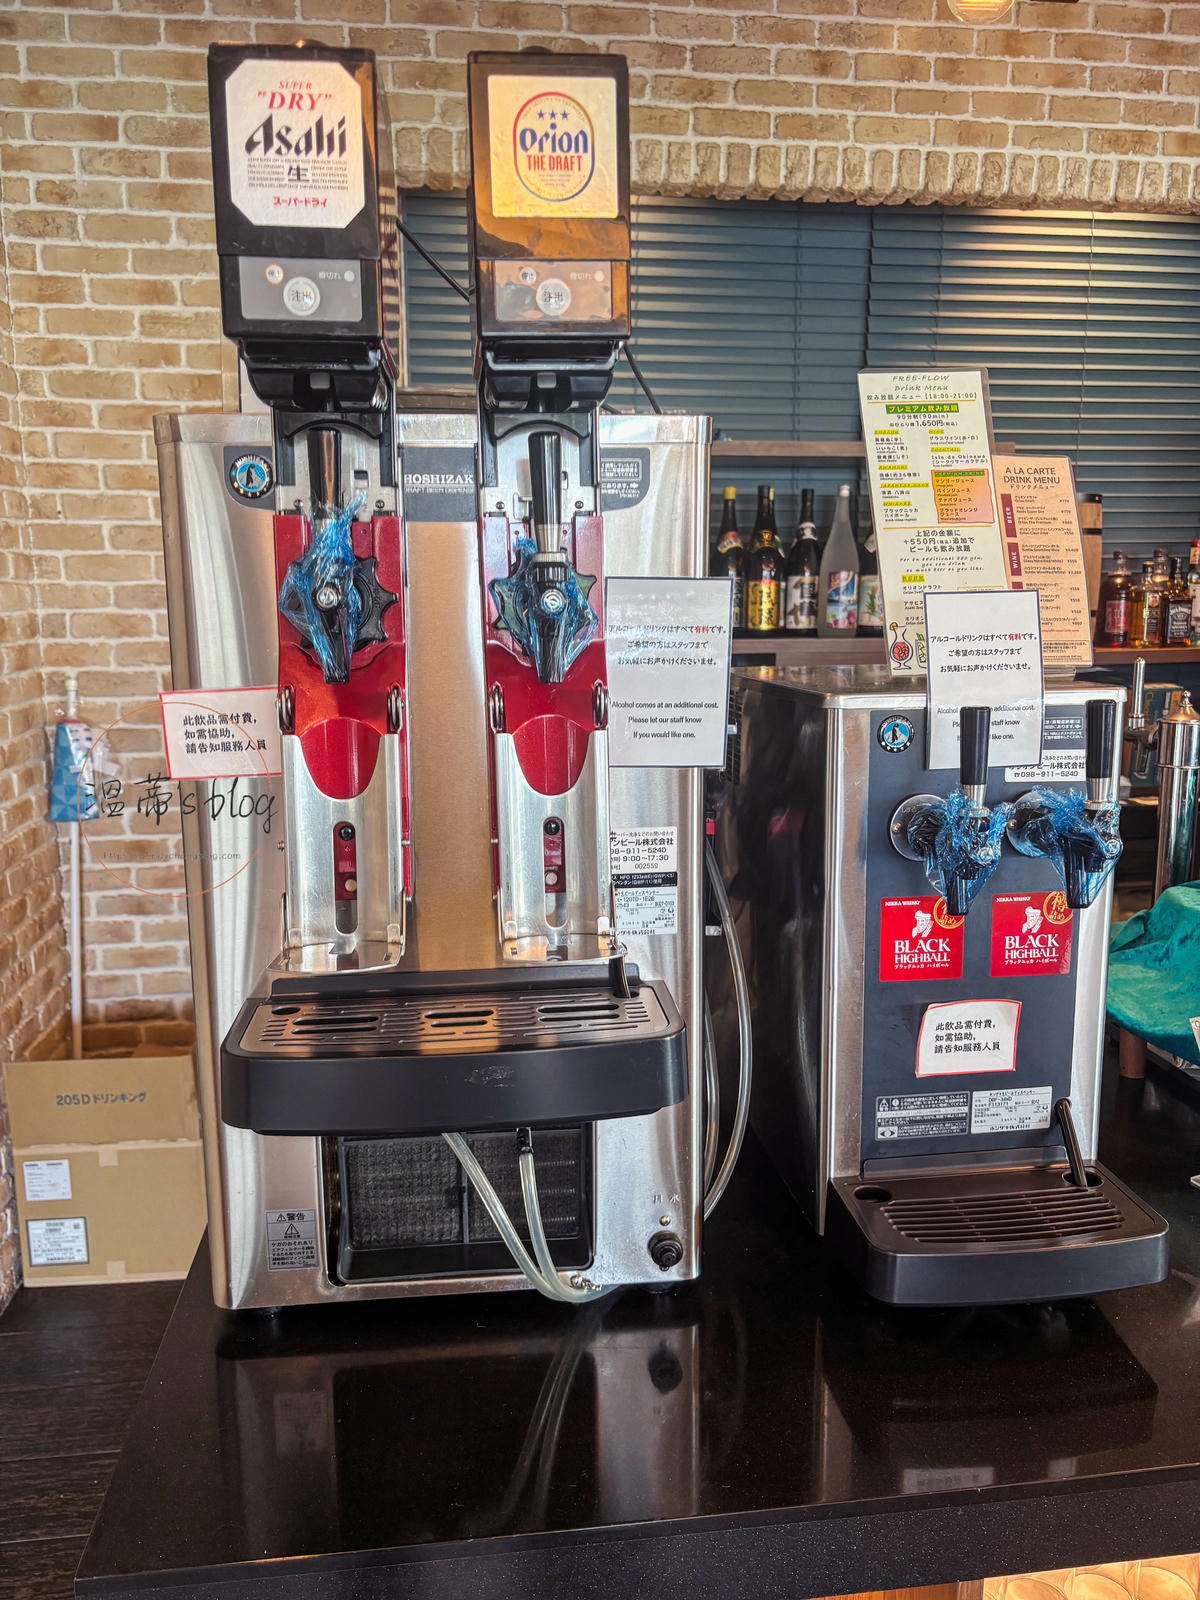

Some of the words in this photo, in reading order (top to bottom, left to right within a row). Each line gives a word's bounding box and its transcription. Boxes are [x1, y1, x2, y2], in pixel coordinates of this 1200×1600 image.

[278, 80, 313, 90] SUPER
[245, 113, 347, 159] Asahi
[519, 122, 588, 154] Orion
[526, 154, 546, 172] THE
[548, 155, 583, 172] DRAFT
[287, 165, 310, 183] 生
[273, 196, 328, 208] スーパードライ
[1005, 467, 1012, 475] A
[1013, 467, 1025, 475] LA
[1026, 467, 1056, 475] CARTE
[1003, 476, 1032, 484] DRINK
[1033, 476, 1061, 484] MENU
[915, 529, 961, 537] 上記の金額に
[909, 545, 971, 553] ビールも飲み放題
[1011, 551, 1019, 569] WINE
[930, 633, 1038, 643] アルコールドリンクはすべて有料です。
[627, 640, 709, 649] ご希望の方はスタッフまで
[948, 647, 1023, 657] ご希望の方はスタッフまで
[940, 663, 1031, 673] お気軽にお声かけくださいませ。
[611, 701, 635, 709] Alcohol
[673, 701, 703, 709] additional
[628, 716, 649, 724] Please
[650, 716, 658, 724] let
[670, 716, 684, 724] staff
[685, 716, 702, 724] know
[991, 719, 1003, 727] staff
[638, 732, 650, 740] you
[651, 731, 670, 739] would
[671, 731, 682, 739] like
[186, 739, 267, 755] 請告知服務人員
[894, 938, 951, 954] BLACK
[1004, 933, 1060, 950] BLACK
[894, 952, 951, 964] HIGHBALL
[1004, 948, 1059, 960] HIGHBALL
[934, 1041, 1001, 1054] 請告知服務人員
